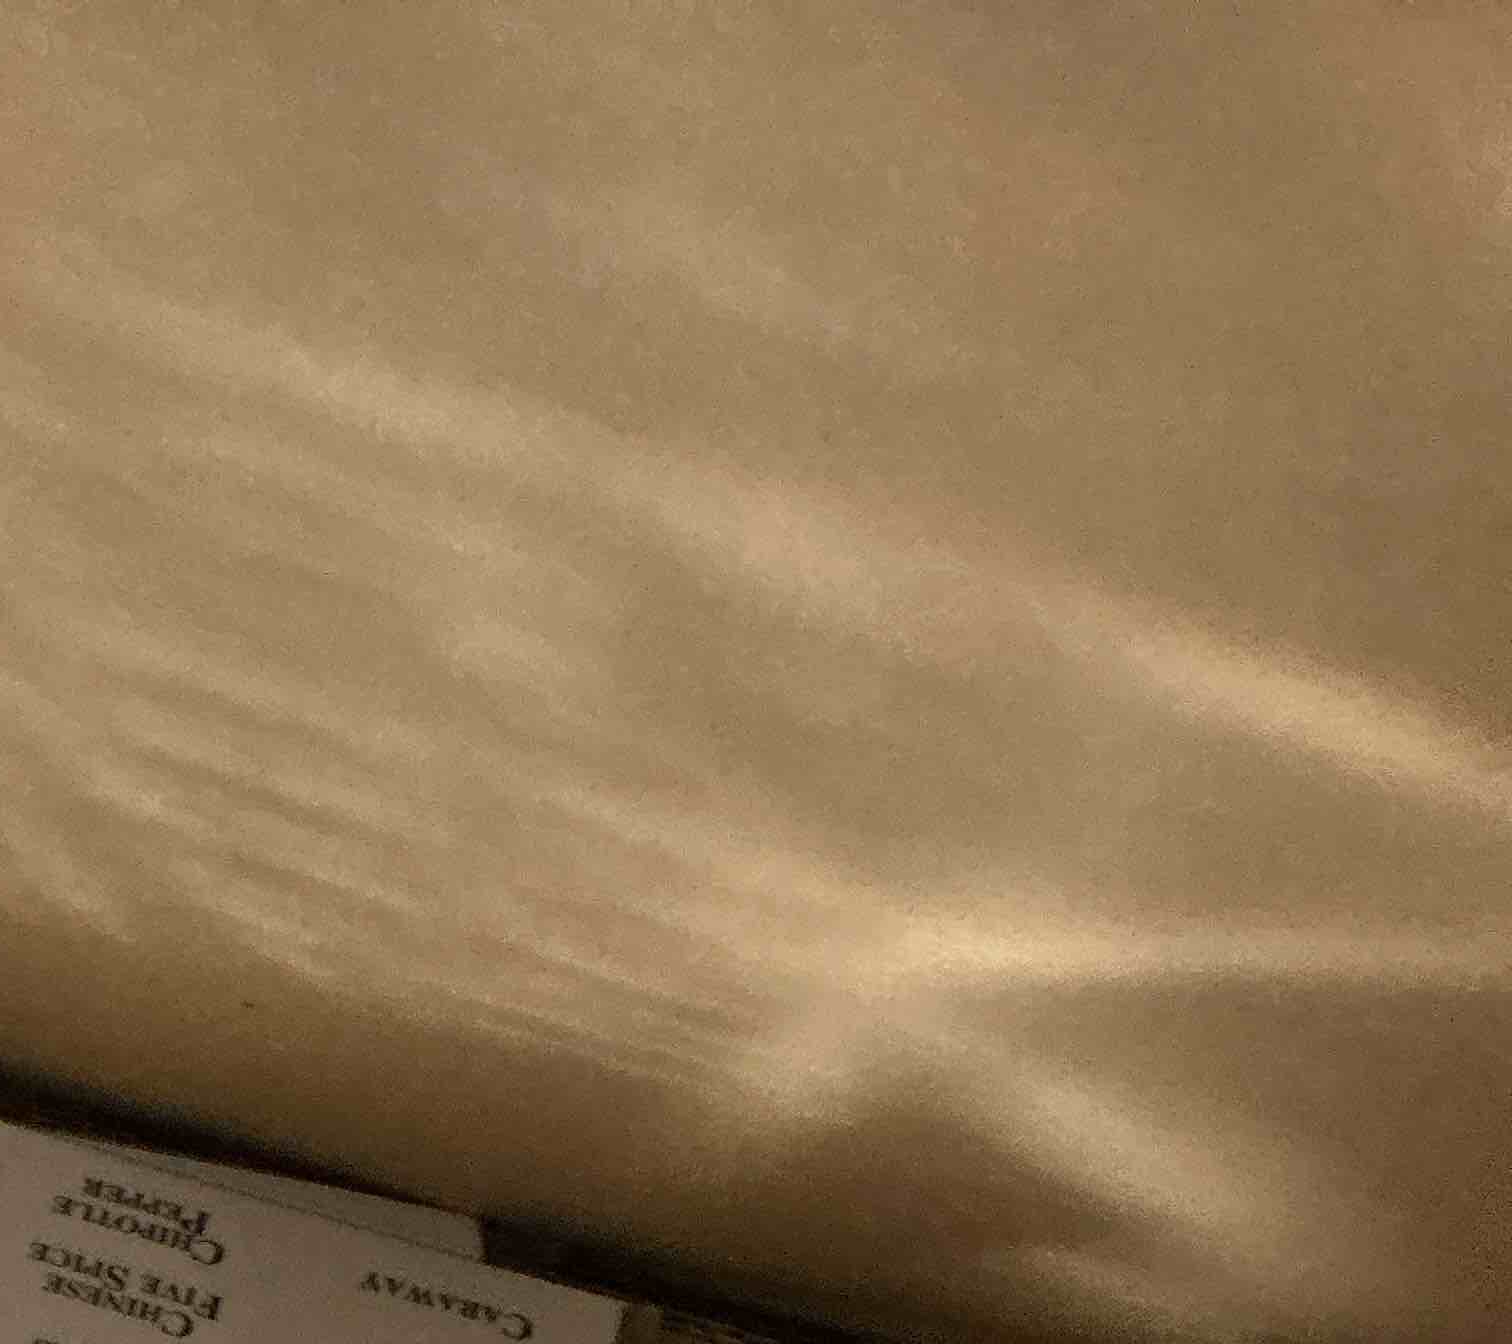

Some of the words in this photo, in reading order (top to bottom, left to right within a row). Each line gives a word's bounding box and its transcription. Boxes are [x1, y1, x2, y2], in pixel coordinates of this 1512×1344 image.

[54, 1194, 224, 1265] CHIPOTLE
[84, 1176, 210, 1237] PEPPER
[29, 1240, 130, 1293] SPICE
[140, 1272, 223, 1322] FIVE
[43, 1272, 194, 1339] CHINESE
[360, 1272, 534, 1341] CARAWAY
